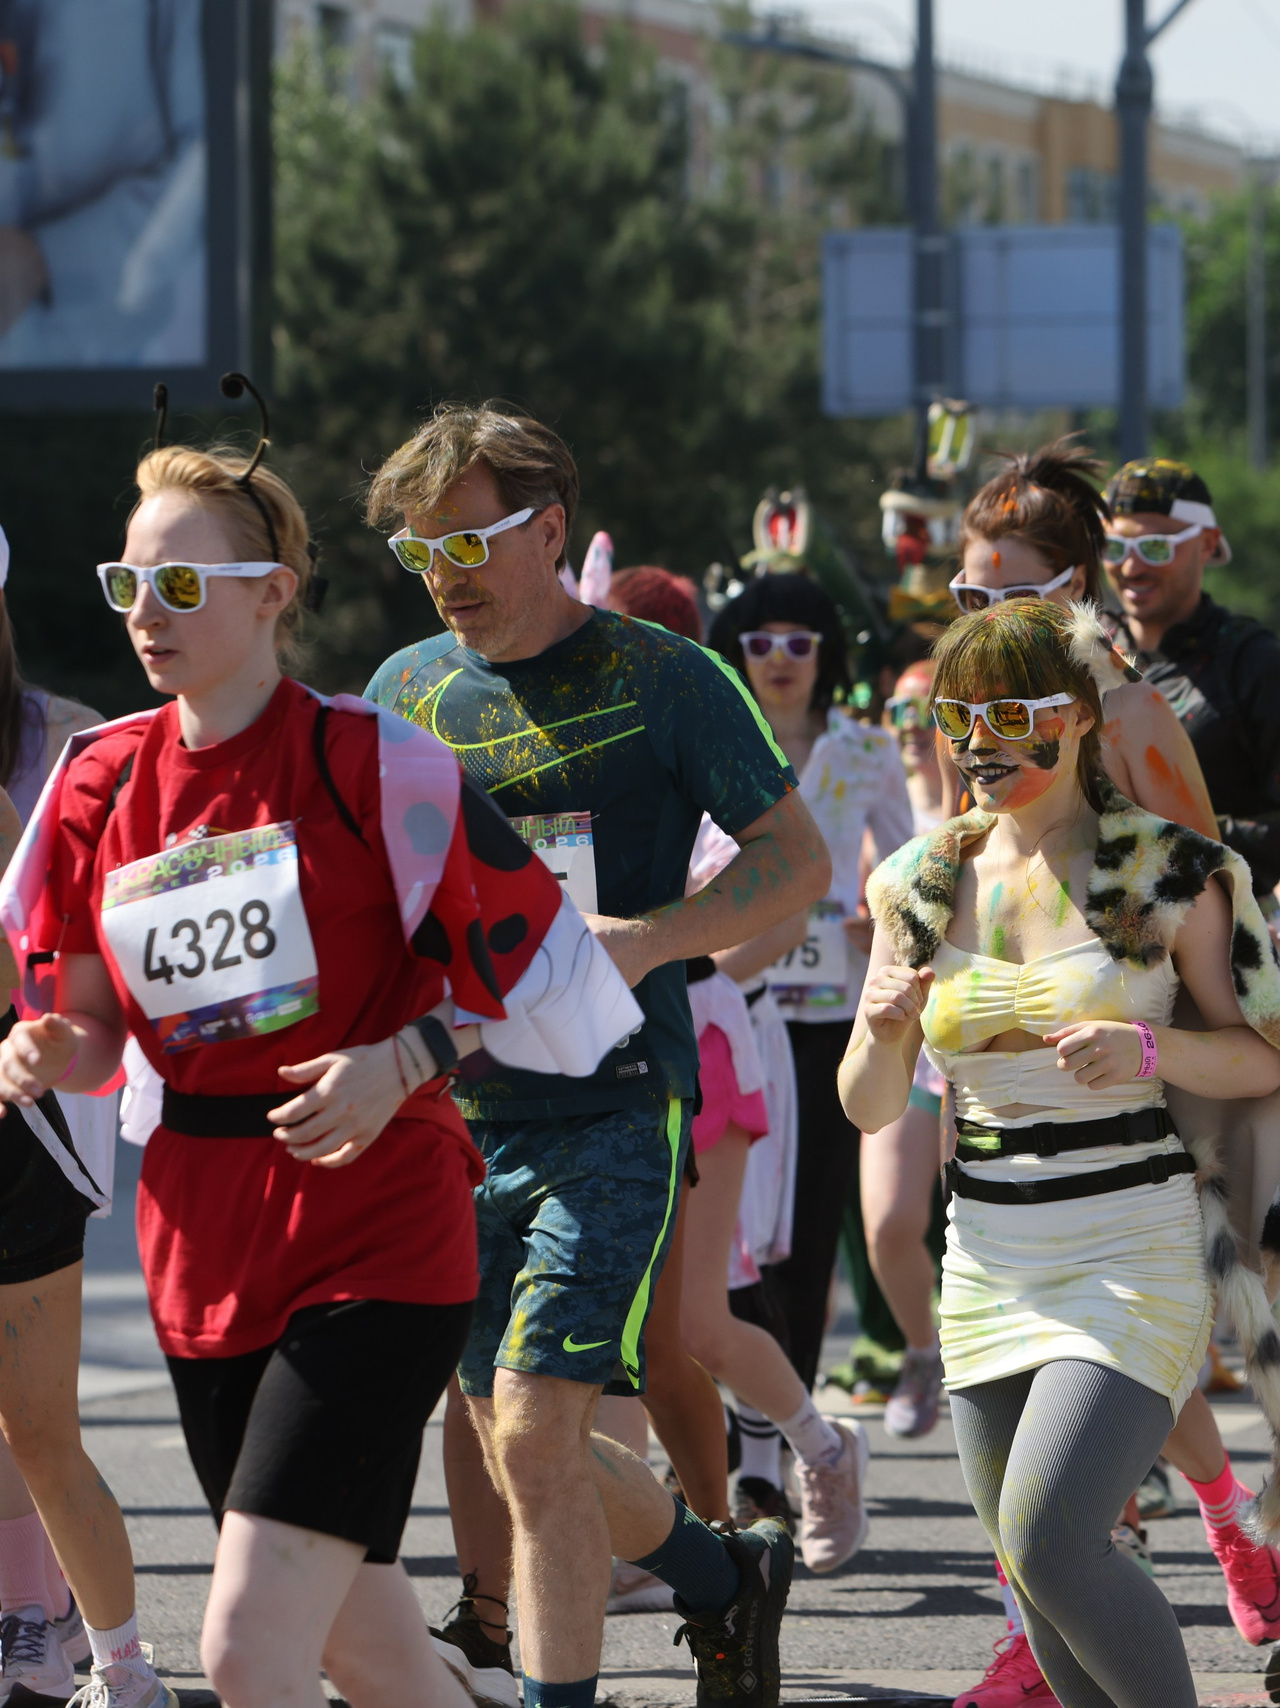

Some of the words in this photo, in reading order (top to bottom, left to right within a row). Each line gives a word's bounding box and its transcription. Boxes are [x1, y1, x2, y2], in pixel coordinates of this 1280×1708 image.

[523, 834, 590, 850] 026
[207, 849, 294, 880] 2026
[143, 899, 277, 985] 4328
